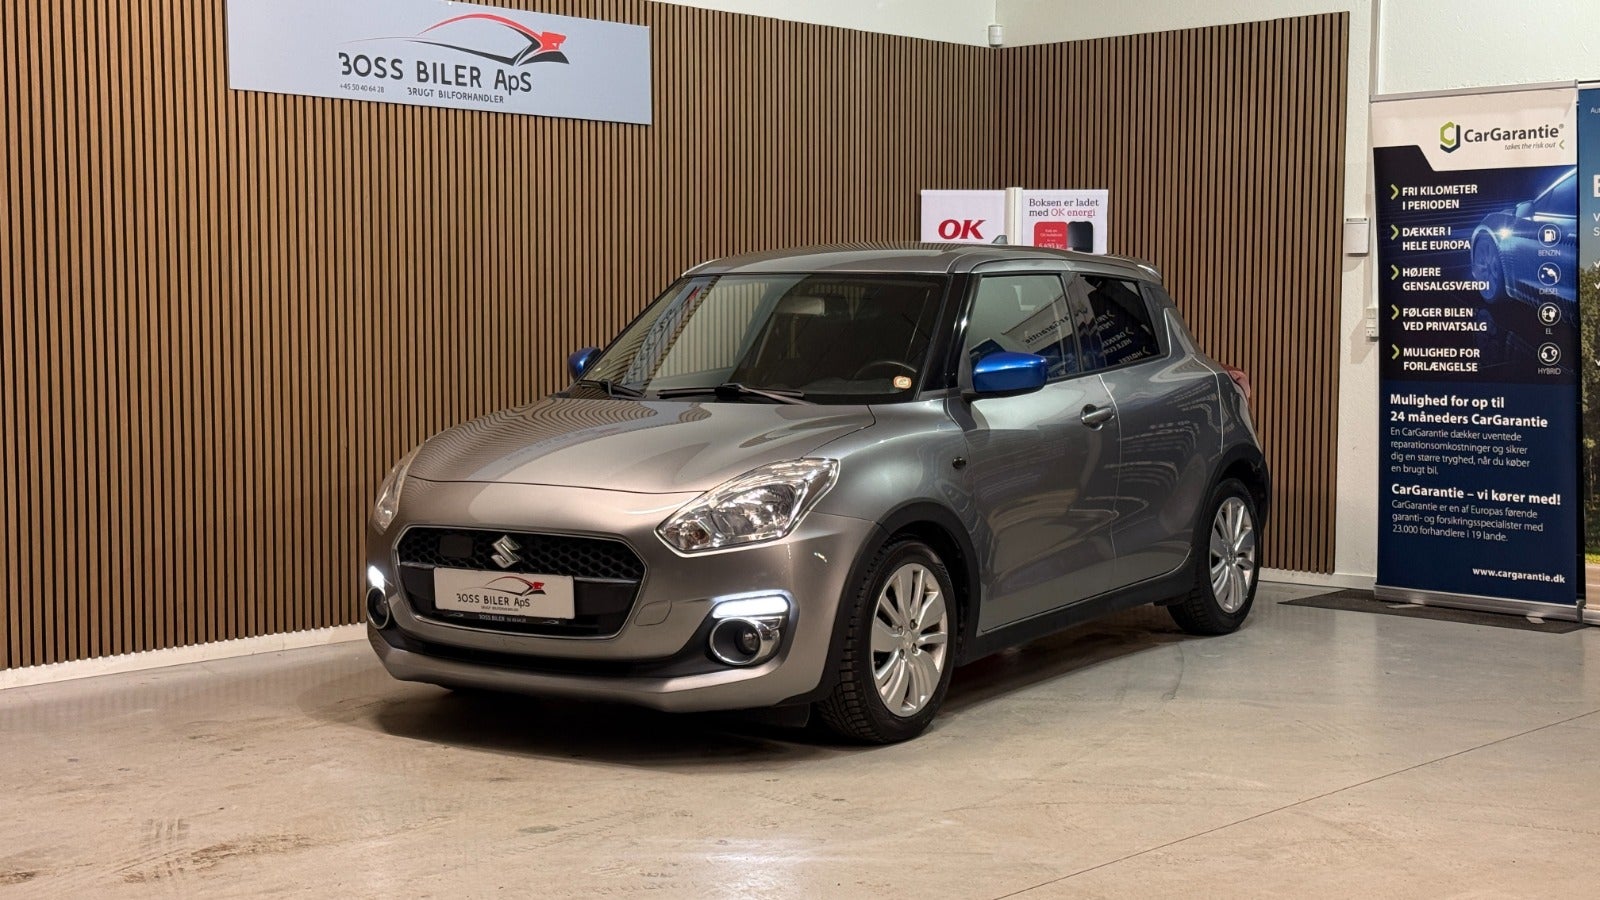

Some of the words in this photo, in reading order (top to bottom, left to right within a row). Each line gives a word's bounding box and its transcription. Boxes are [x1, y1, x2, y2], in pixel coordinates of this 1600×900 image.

[417, 61, 482, 88] BILER
[494, 69, 531, 95] ApS
[439, 90, 504, 103] BILFORHANDLER
[1403, 187, 1417, 196] FRI
[1420, 184, 1478, 195] KILOMETER
[1029, 199, 1062, 207] Boksen
[1076, 199, 1099, 207] ladet
[1403, 202, 1405, 210] I
[1408, 200, 1459, 210] PERIODEN
[1067, 209, 1096, 218] energi
[938, 219, 986, 240] OK
[1403, 227, 1445, 236] DÆKKER
[1448, 227, 1451, 235] I
[1403, 242, 1427, 250] HELE
[1430, 240, 1471, 250] EUROPA
[1403, 268, 1441, 277] HØJERE
[1403, 281, 1489, 291] GENSALGSVÆRDI
[1403, 308, 1442, 317] FØLGER
[1444, 308, 1473, 317] BILEN
[1403, 322, 1423, 330] VED
[1426, 322, 1487, 331] PRIVATSALG
[1404, 348, 1457, 357] MULIGHED
[1460, 348, 1480, 358] FOR
[1404, 362, 1478, 372] FORLÆNGELSE
[1390, 394, 1447, 408] Mulighed
[1451, 395, 1469, 406] for
[1472, 398, 1488, 410] op
[1491, 396, 1504, 408] til
[1390, 411, 1405, 421] 24
[1408, 411, 1468, 424] måneders
[1472, 414, 1548, 428] CarGarantie
[1390, 427, 1400, 435] En
[1402, 428, 1448, 437] CarGarantie
[1450, 430, 1480, 439] dækker
[1482, 432, 1521, 441] uventede
[1391, 440, 1490, 454] reparationsomkostninger
[1493, 446, 1503, 455] og
[1506, 445, 1528, 454] sikrer
[1391, 452, 1403, 462] dig
[1418, 454, 1440, 462] større
[1442, 455, 1476, 465] tryghed,
[1478, 456, 1490, 464] når
[1493, 457, 1503, 466] du
[1506, 457, 1530, 467] køber
[1403, 464, 1425, 475] brugt
[1427, 465, 1438, 474] bil.
[1392, 484, 1464, 498] CarGarantie
[1477, 489, 1488, 500] vi
[1492, 489, 1525, 502] kører
[1529, 494, 1561, 505] med!
[1392, 500, 1437, 511] CarGarantie
[1471, 505, 1503, 516] Europas
[1505, 507, 1537, 518] førende
[1392, 514, 1422, 522] garanti-
[1424, 516, 1434, 525] og
[1437, 515, 1522, 530] forsikringsspecialister
[1524, 523, 1543, 532] med
[1392, 524, 1418, 533] 23.000
[1420, 526, 1465, 538] forhandlere
[1472, 530, 1481, 539] 19
[1483, 531, 1508, 541] lande.
[1472, 568, 1565, 583] www.cargarantie.dk
[484, 595, 509, 606] BILER
[514, 597, 530, 608] ApS
